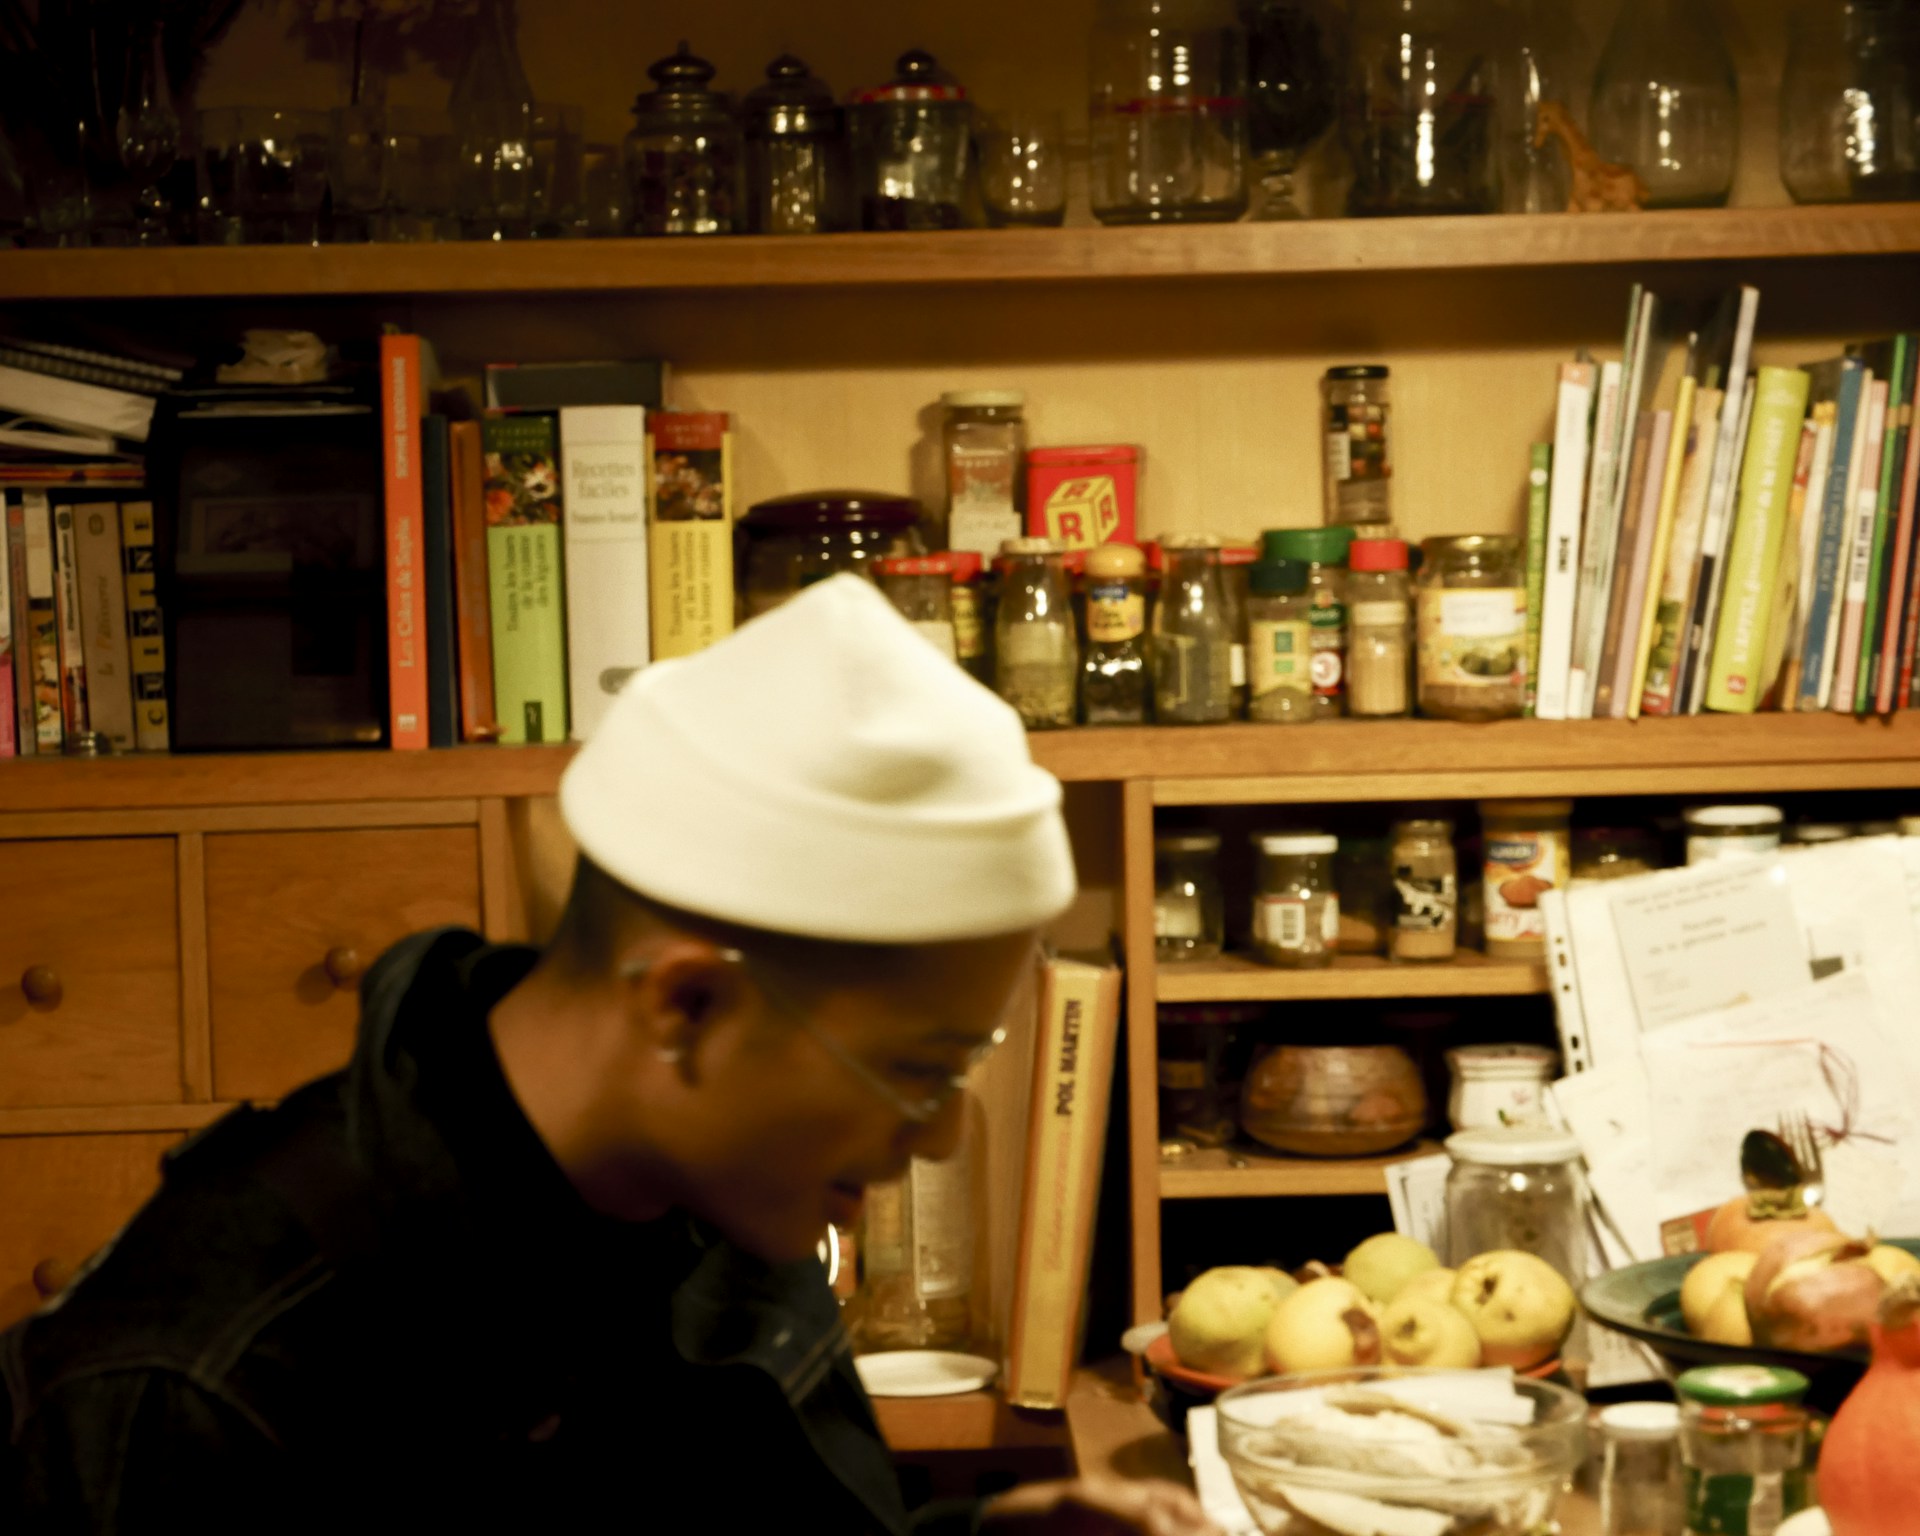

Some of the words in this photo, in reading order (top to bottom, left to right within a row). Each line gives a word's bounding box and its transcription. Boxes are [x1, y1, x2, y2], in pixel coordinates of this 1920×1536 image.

[1058, 512, 1085, 542] R
[396, 569, 413, 589] de
[133, 517, 165, 726] CUISINE
